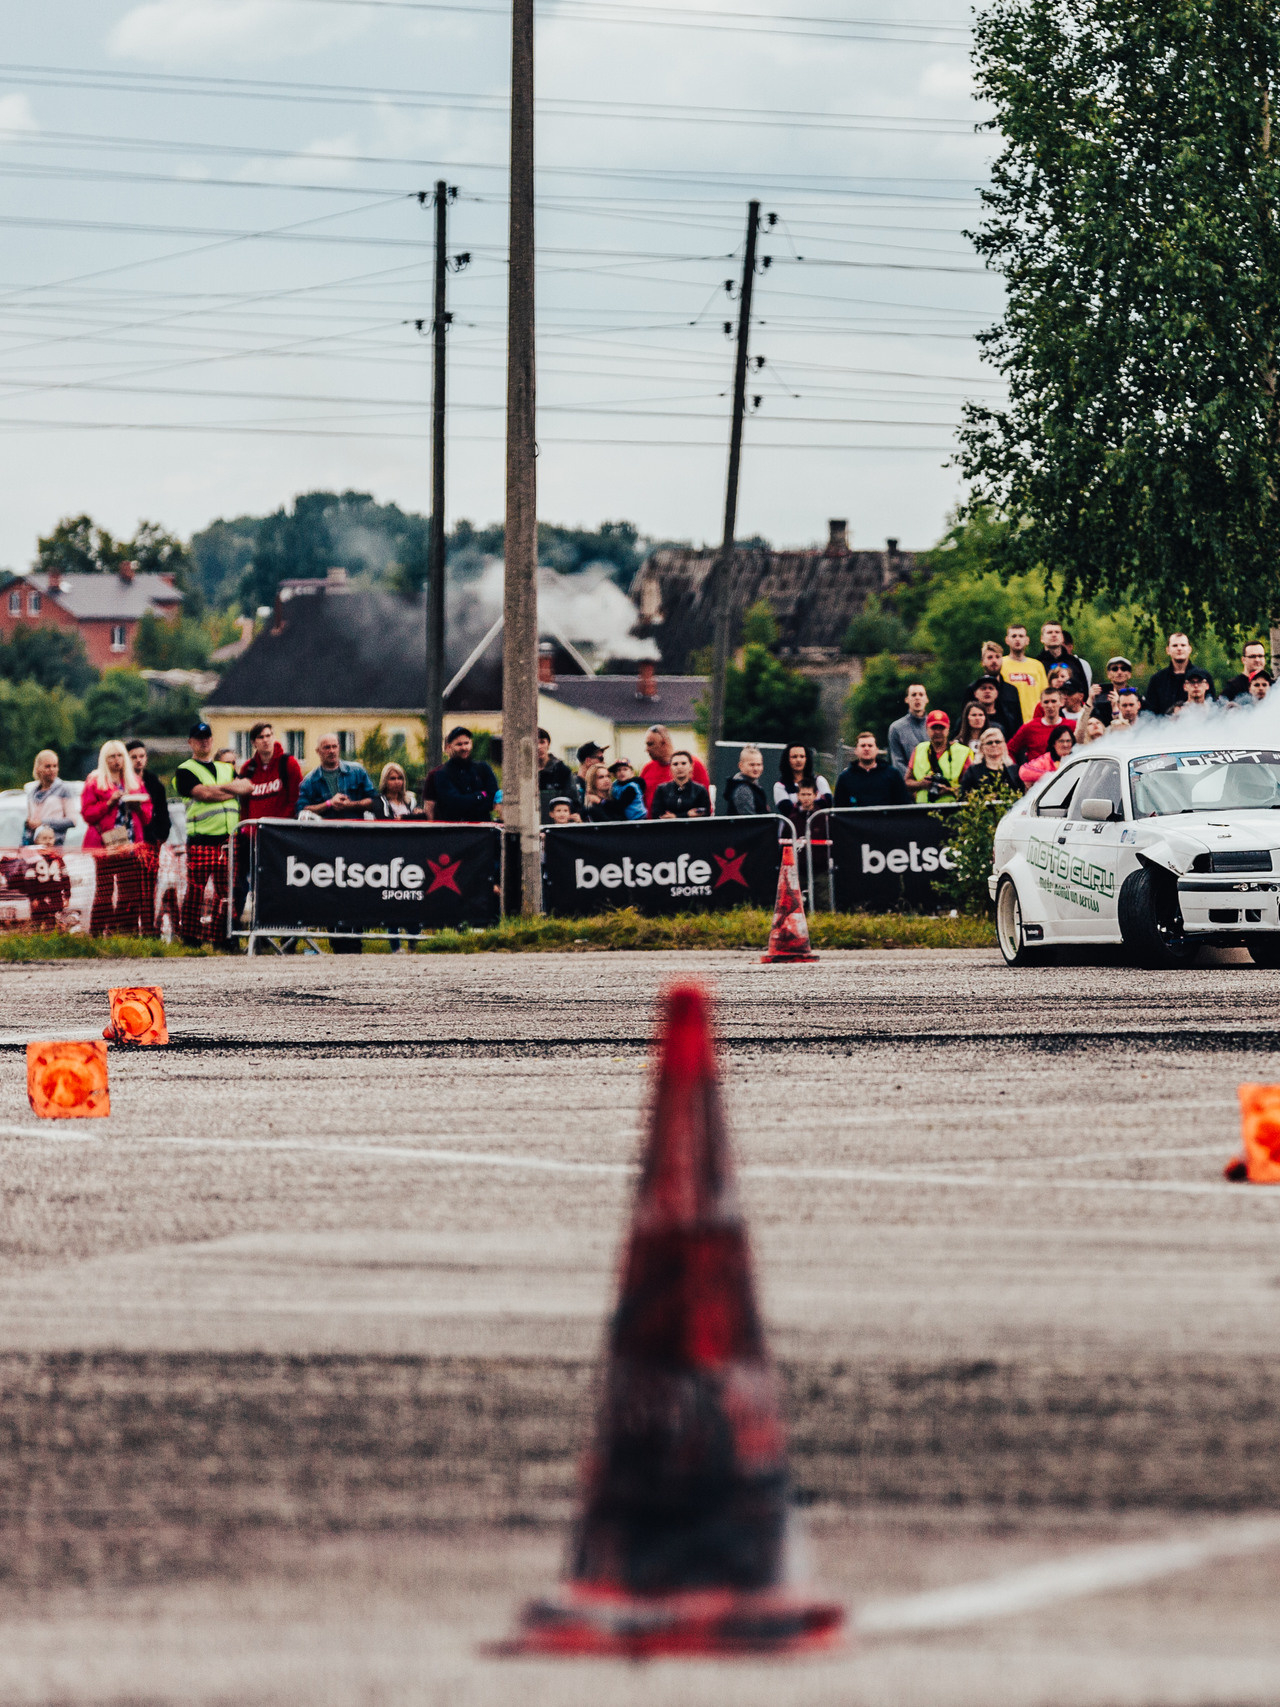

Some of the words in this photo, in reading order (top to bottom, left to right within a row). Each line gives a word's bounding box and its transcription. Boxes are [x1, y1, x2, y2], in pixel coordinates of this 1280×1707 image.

[1180, 751, 1262, 767] DRIFT
[286, 856, 425, 889] betsafe
[575, 853, 712, 889] betsafe
[861, 841, 958, 875] betsa
[1026, 835, 1070, 880] MOTO
[1070, 856, 1114, 899] GURU
[382, 889, 424, 901] SPORTS
[671, 885, 712, 897] SPORTS
